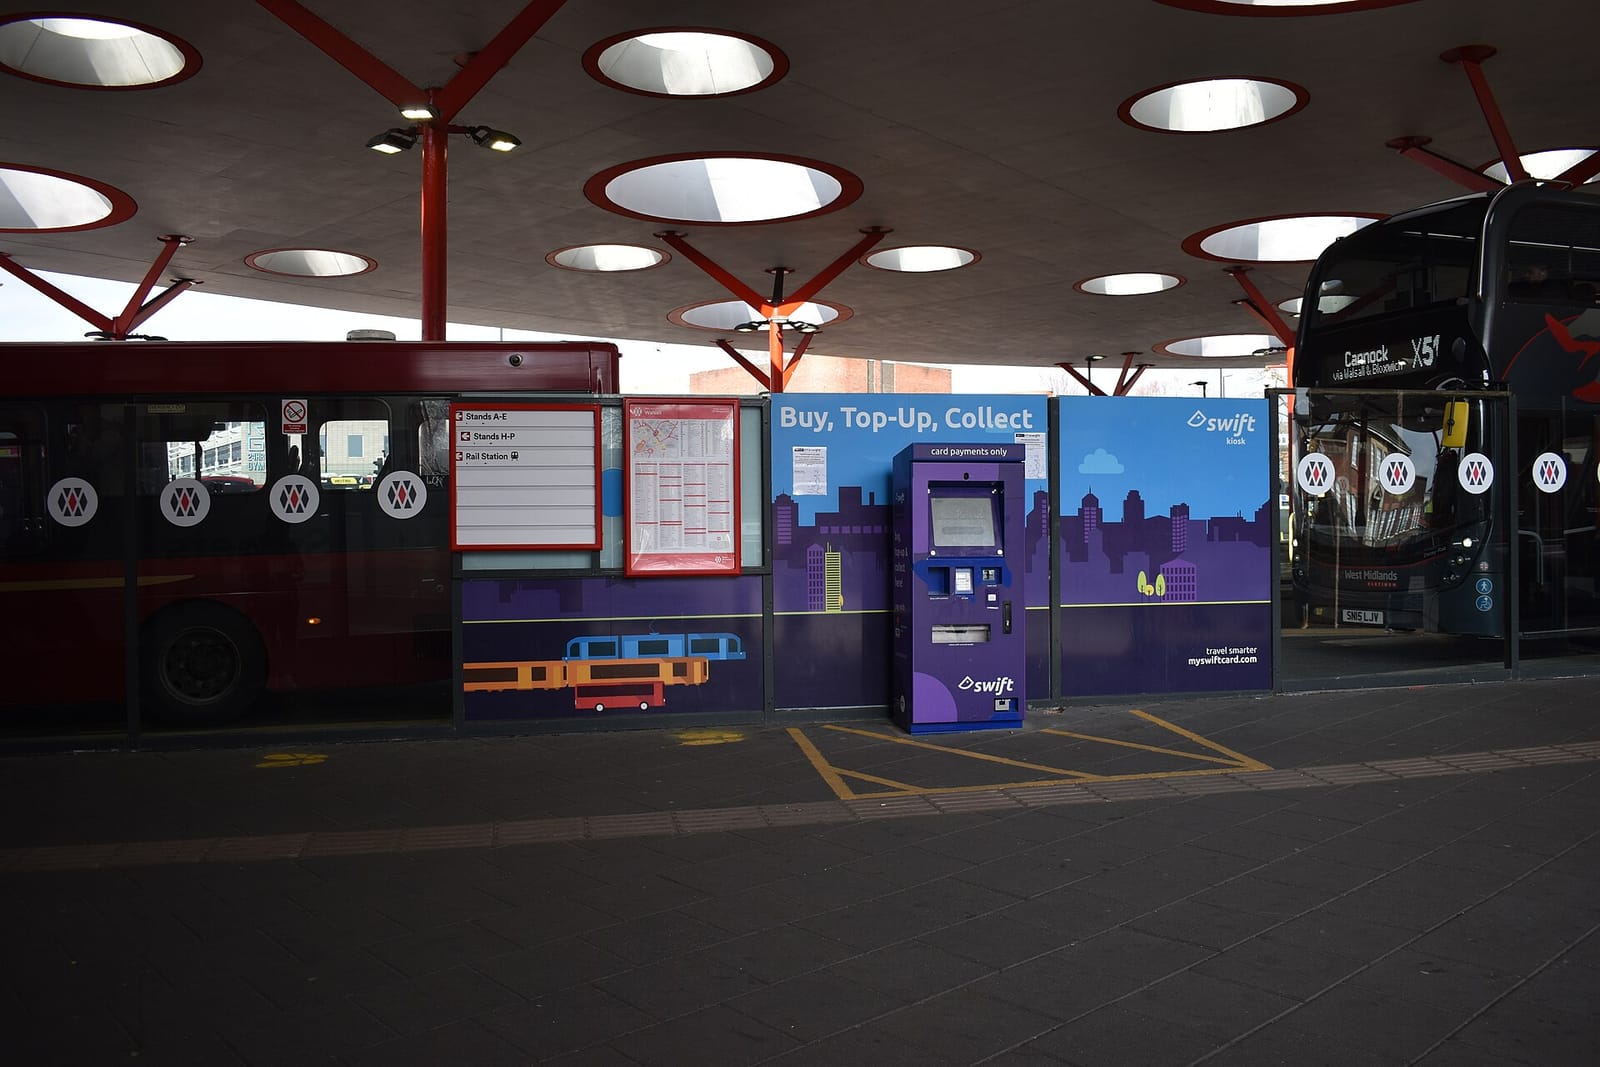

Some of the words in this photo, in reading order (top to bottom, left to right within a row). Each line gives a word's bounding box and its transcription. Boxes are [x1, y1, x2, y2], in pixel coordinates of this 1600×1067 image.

[1344, 344, 1388, 368] Cannock
[1411, 334, 1441, 369] X51
[1332, 370, 1344, 381] via
[465, 412, 492, 421] Stands
[493, 413, 508, 421] A-E
[779, 406, 834, 433] Buy,
[840, 407, 938, 433] Top-Up,
[945, 406, 1033, 430] Collect
[1206, 412, 1256, 437] swift
[473, 432, 500, 441] Stands
[500, 432, 516, 441] H-P
[1226, 437, 1246, 445] kiosk
[465, 452, 480, 460] Rail
[481, 452, 509, 460] Station
[931, 447, 949, 456] card
[950, 448, 989, 457] payments
[989, 447, 1008, 457] only
[1344, 569, 1363, 581] West
[1363, 569, 1400, 581] Midlands
[1346, 610, 1363, 621] SN15
[1363, 611, 1379, 622] LJV
[1206, 646, 1228, 655] travel
[1228, 646, 1258, 655] smarter
[1188, 655, 1258, 667] myswiftcard.com
[973, 676, 1015, 696] swift
